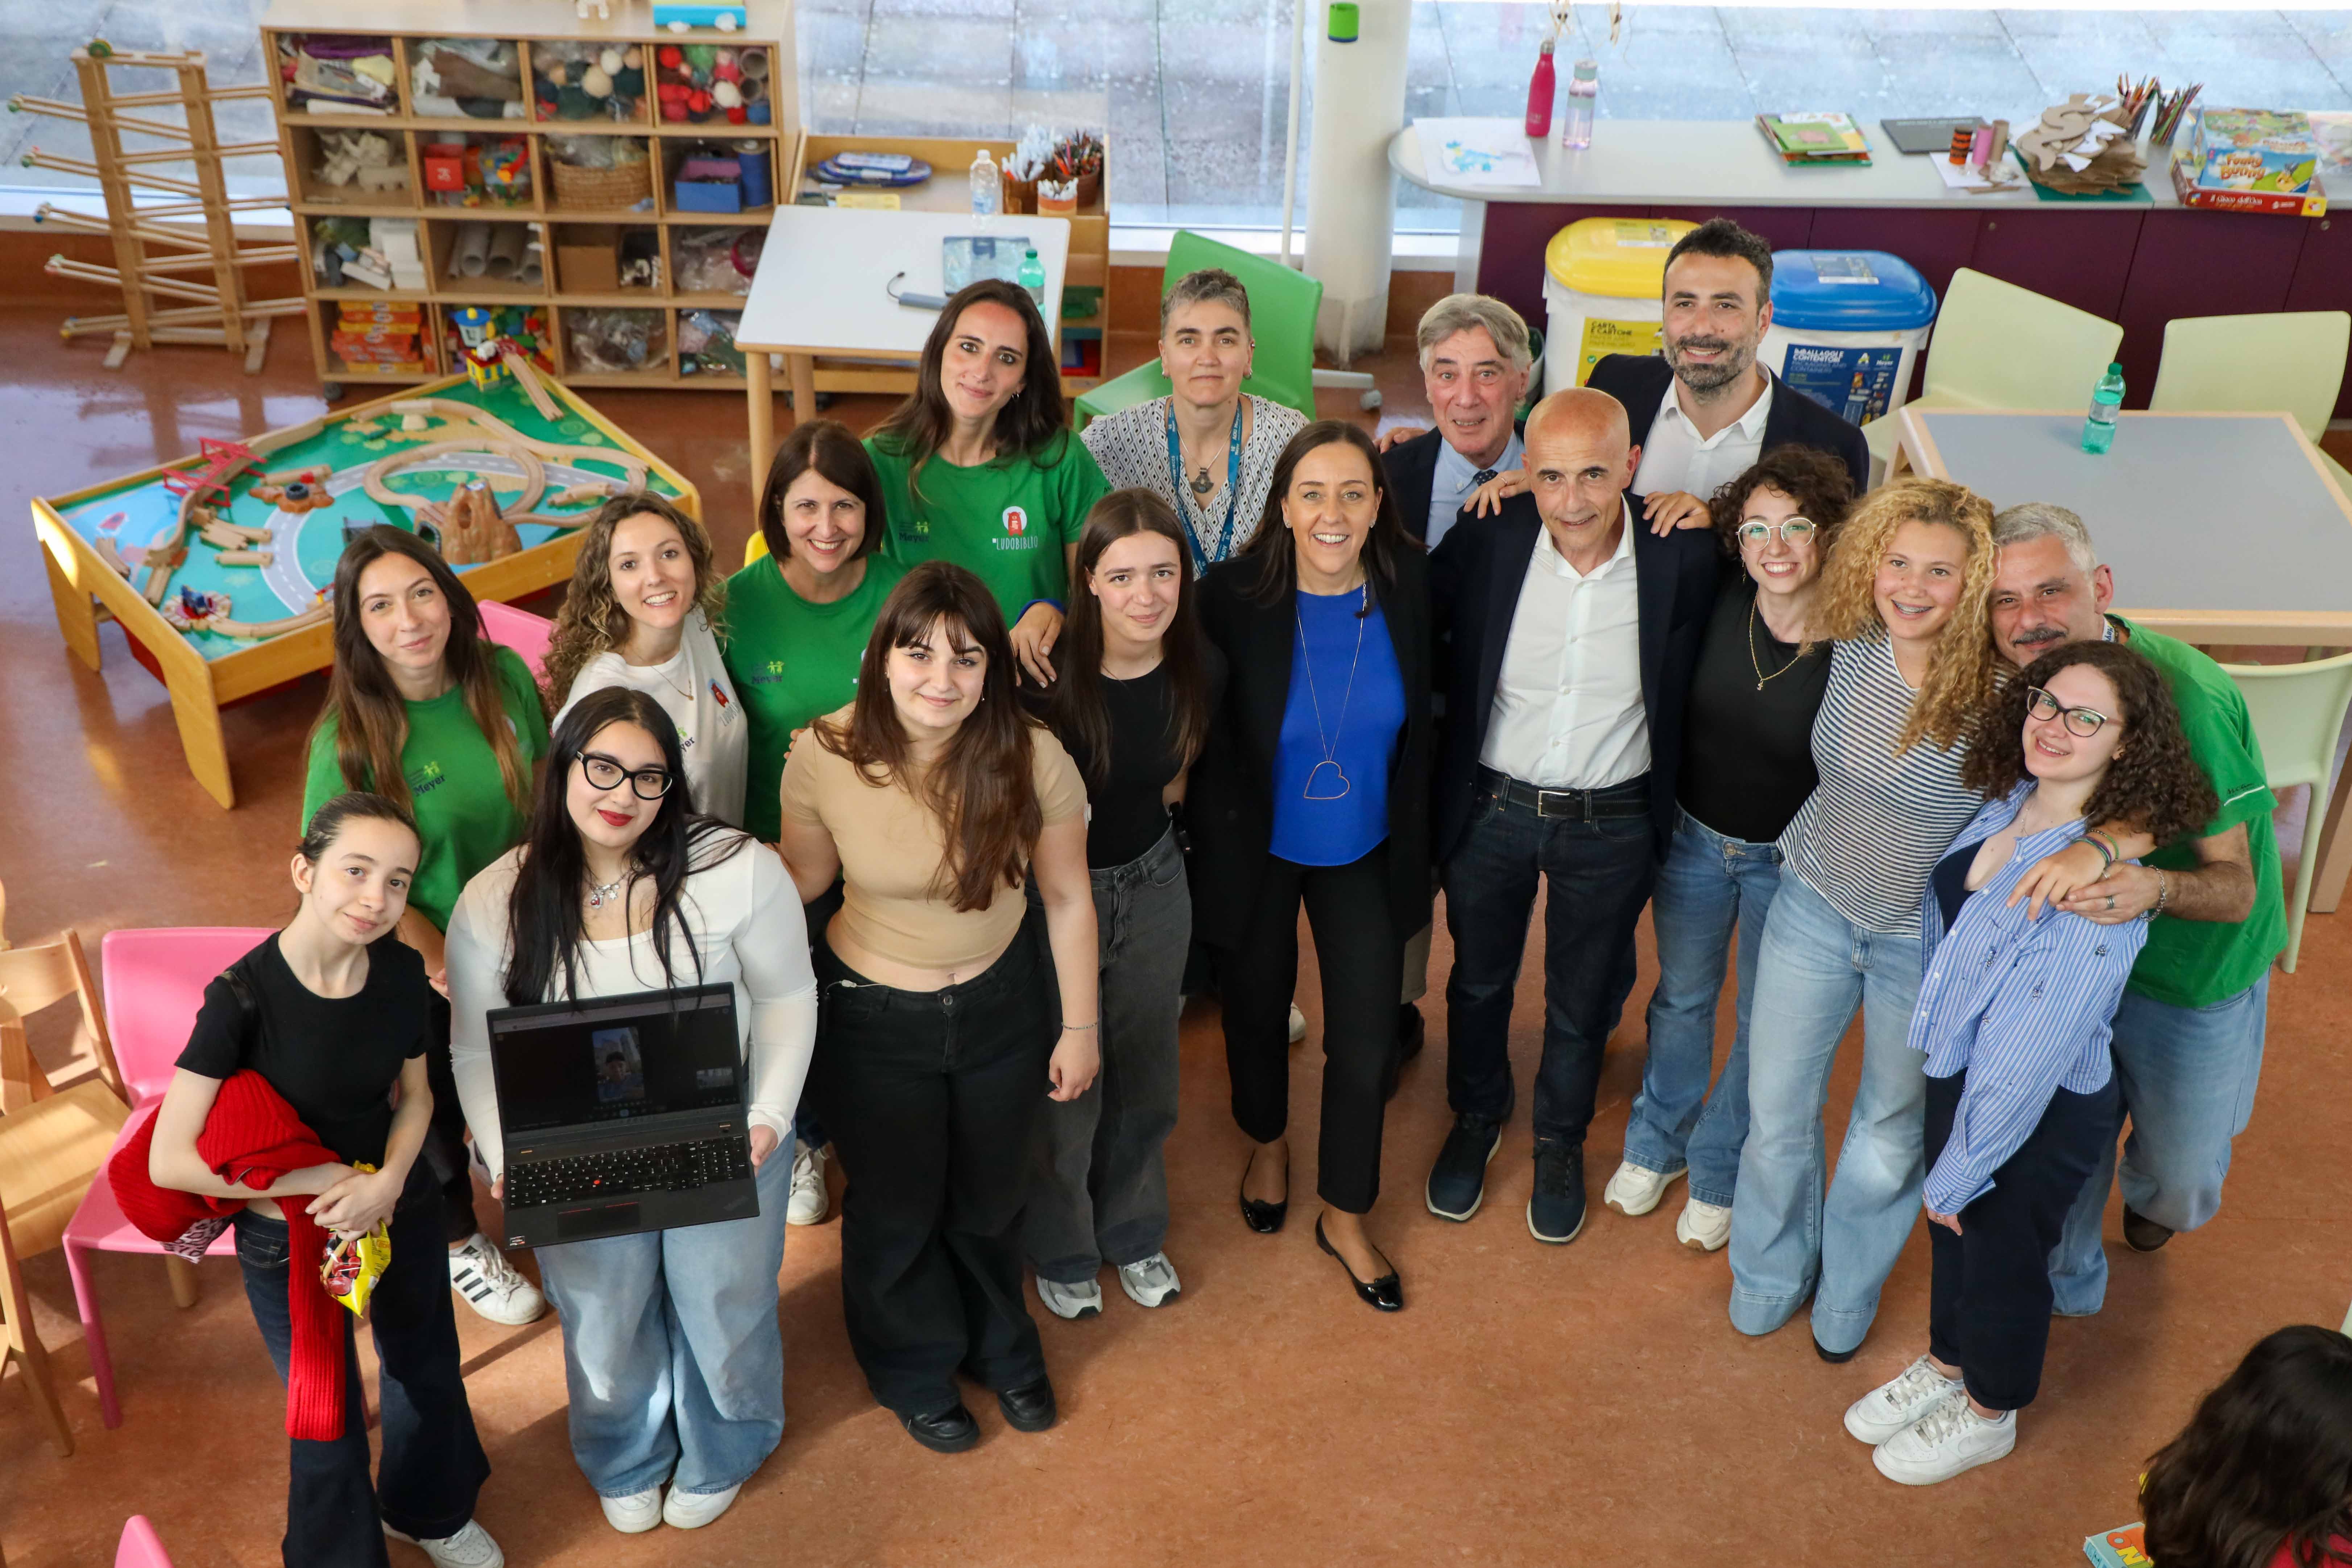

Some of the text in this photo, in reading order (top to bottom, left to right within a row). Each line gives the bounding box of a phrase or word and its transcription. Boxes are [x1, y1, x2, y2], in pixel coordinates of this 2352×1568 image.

[2221, 165, 2265, 180] Bunny
[997, 535, 1038, 550] LUDOBIBLIO
[751, 675, 783, 685] Meyer
[679, 737, 695, 756] yer
[414, 774, 446, 797] Meyer
